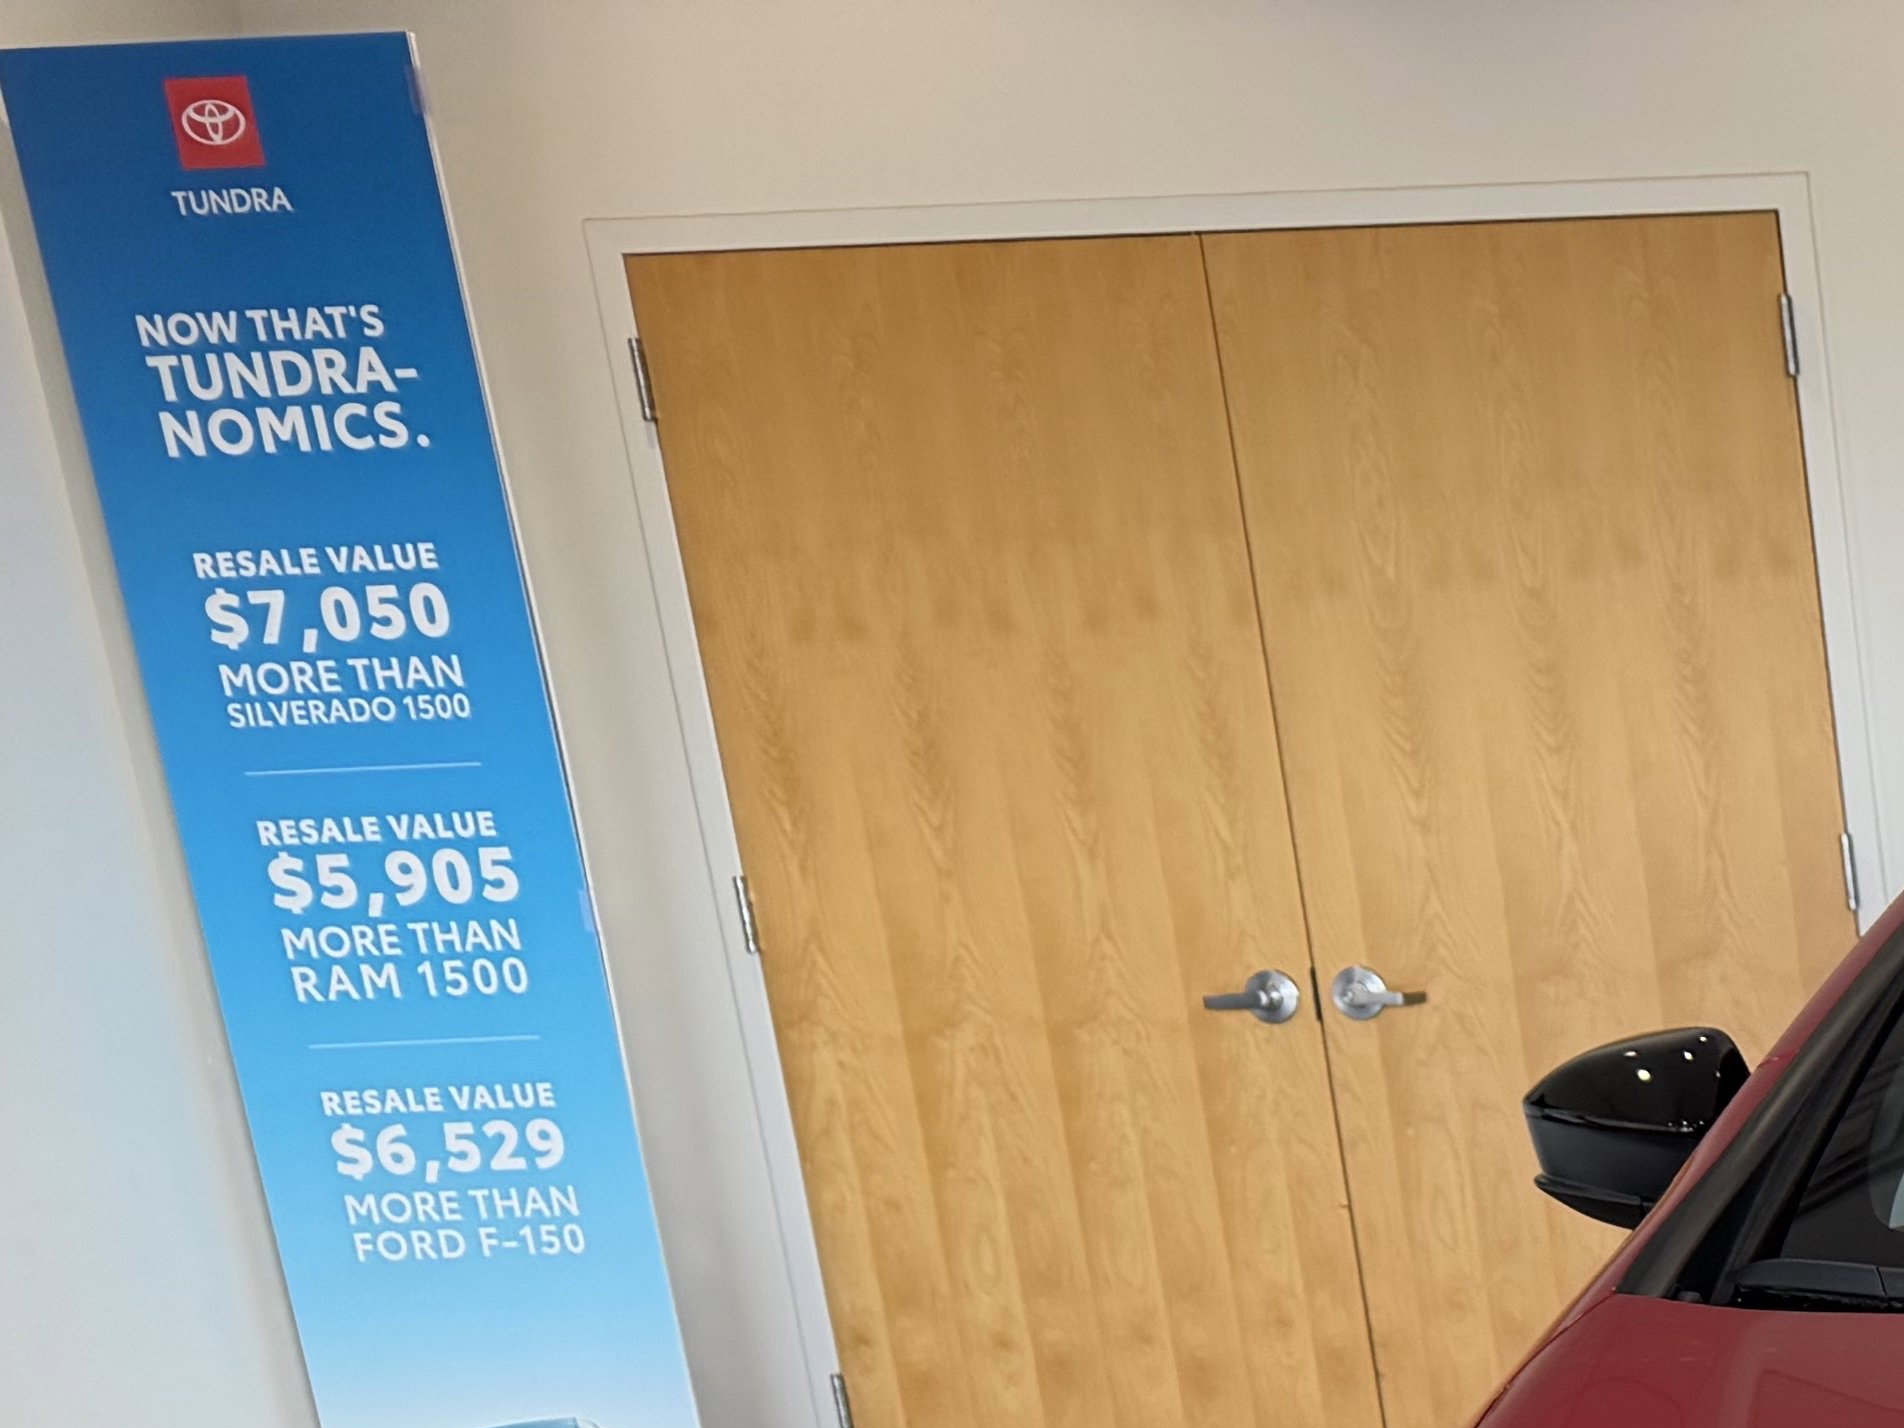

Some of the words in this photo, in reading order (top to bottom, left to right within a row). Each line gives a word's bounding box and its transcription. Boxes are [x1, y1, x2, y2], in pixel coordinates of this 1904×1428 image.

[171, 186, 294, 216] TUNDRA
[135, 310, 237, 347] NOW
[245, 304, 385, 342] THAT'S
[145, 346, 419, 402] TUNDRA-
[159, 401, 430, 459] NOMICS.
[192, 547, 322, 579] RESALE
[324, 541, 440, 574] VALUE
[204, 582, 450, 653] $7,050
[218, 659, 343, 697] MORE
[346, 654, 467, 691] THAN
[226, 696, 397, 729] SILVERADO
[403, 693, 472, 721] 1500
[256, 816, 383, 847] RESALE
[386, 811, 498, 841] VALUE
[267, 846, 520, 918] $5,905
[280, 923, 403, 960] MORE
[406, 918, 523, 955] THAN
[290, 962, 403, 1003] RAM
[416, 957, 529, 998] 1500
[320, 1086, 445, 1116] RESALE
[448, 1081, 557, 1110] VALUE
[331, 1118, 565, 1184] $6,529
[344, 1190, 466, 1226] MORE
[467, 1184, 580, 1220] THAN
[353, 1228, 467, 1263] FORD
[478, 1222, 586, 1258] F-150
